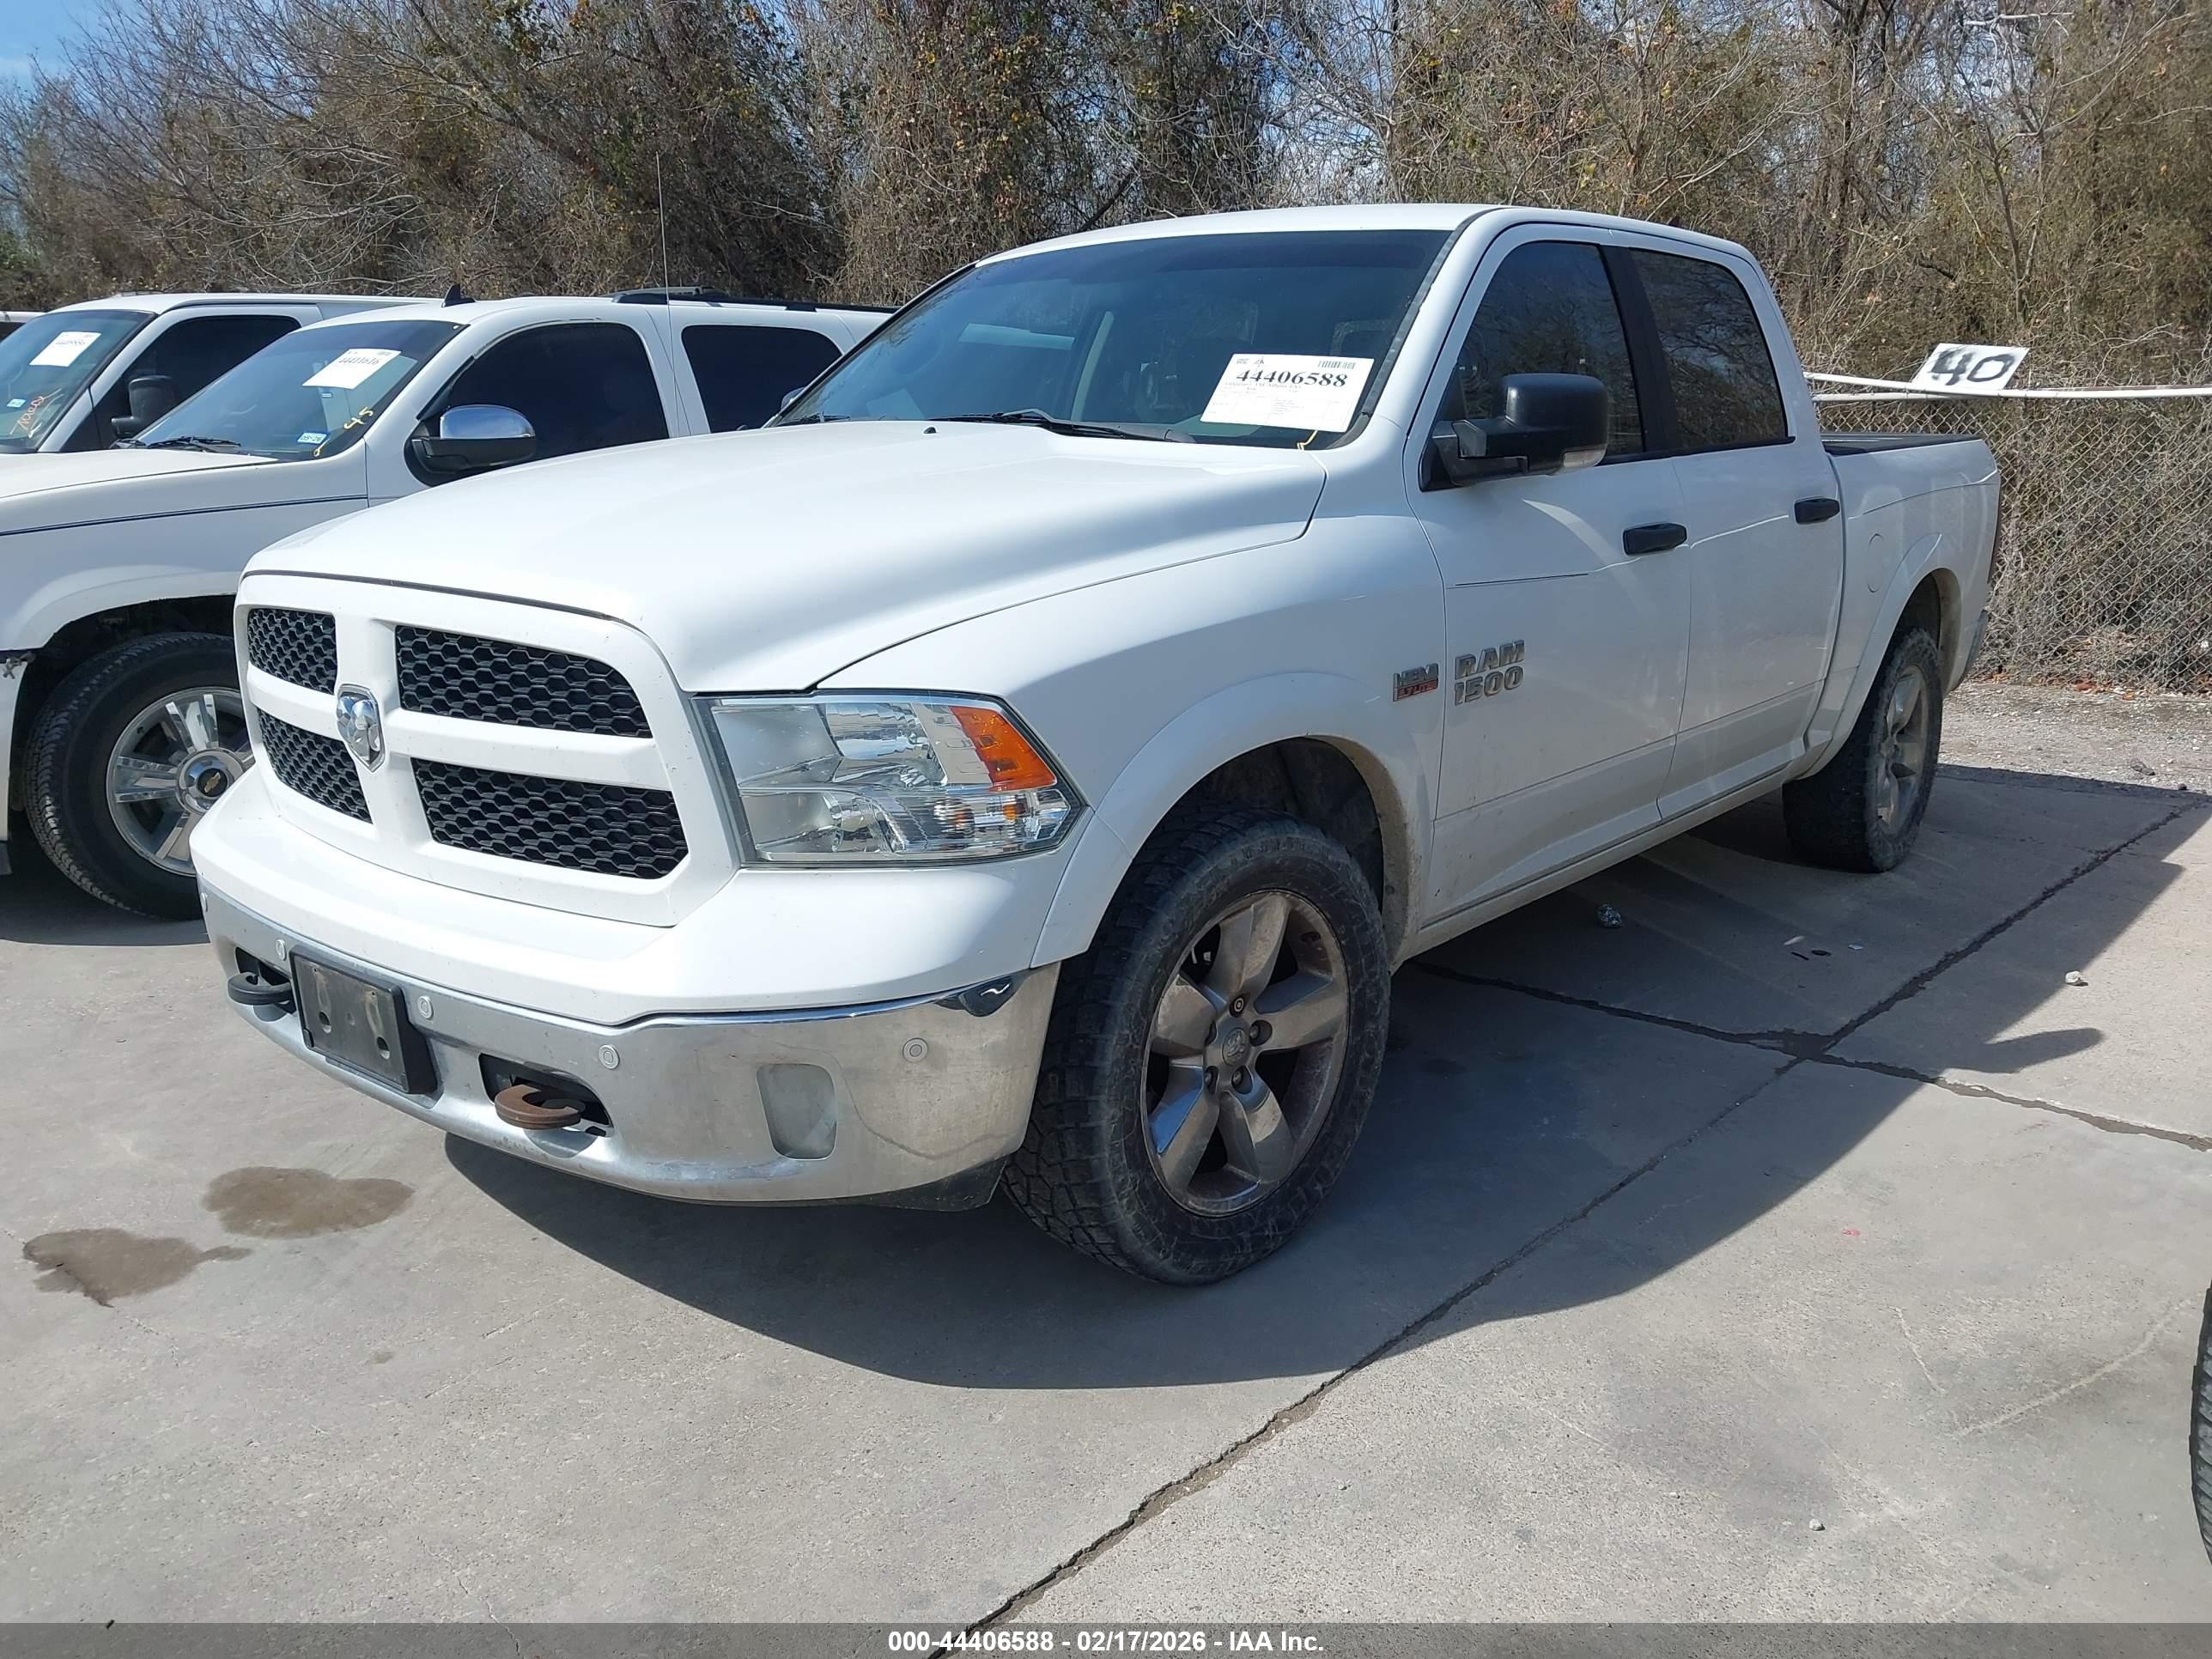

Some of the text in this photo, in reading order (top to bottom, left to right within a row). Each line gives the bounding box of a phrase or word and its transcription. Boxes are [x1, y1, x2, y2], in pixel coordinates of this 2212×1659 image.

[1236, 368, 1348, 387] 44406588
[1929, 347, 2015, 386] 40
[1393, 662, 1439, 689] HEMI
[1455, 639, 1525, 680] RAM
[1455, 665, 1524, 707] 1500
